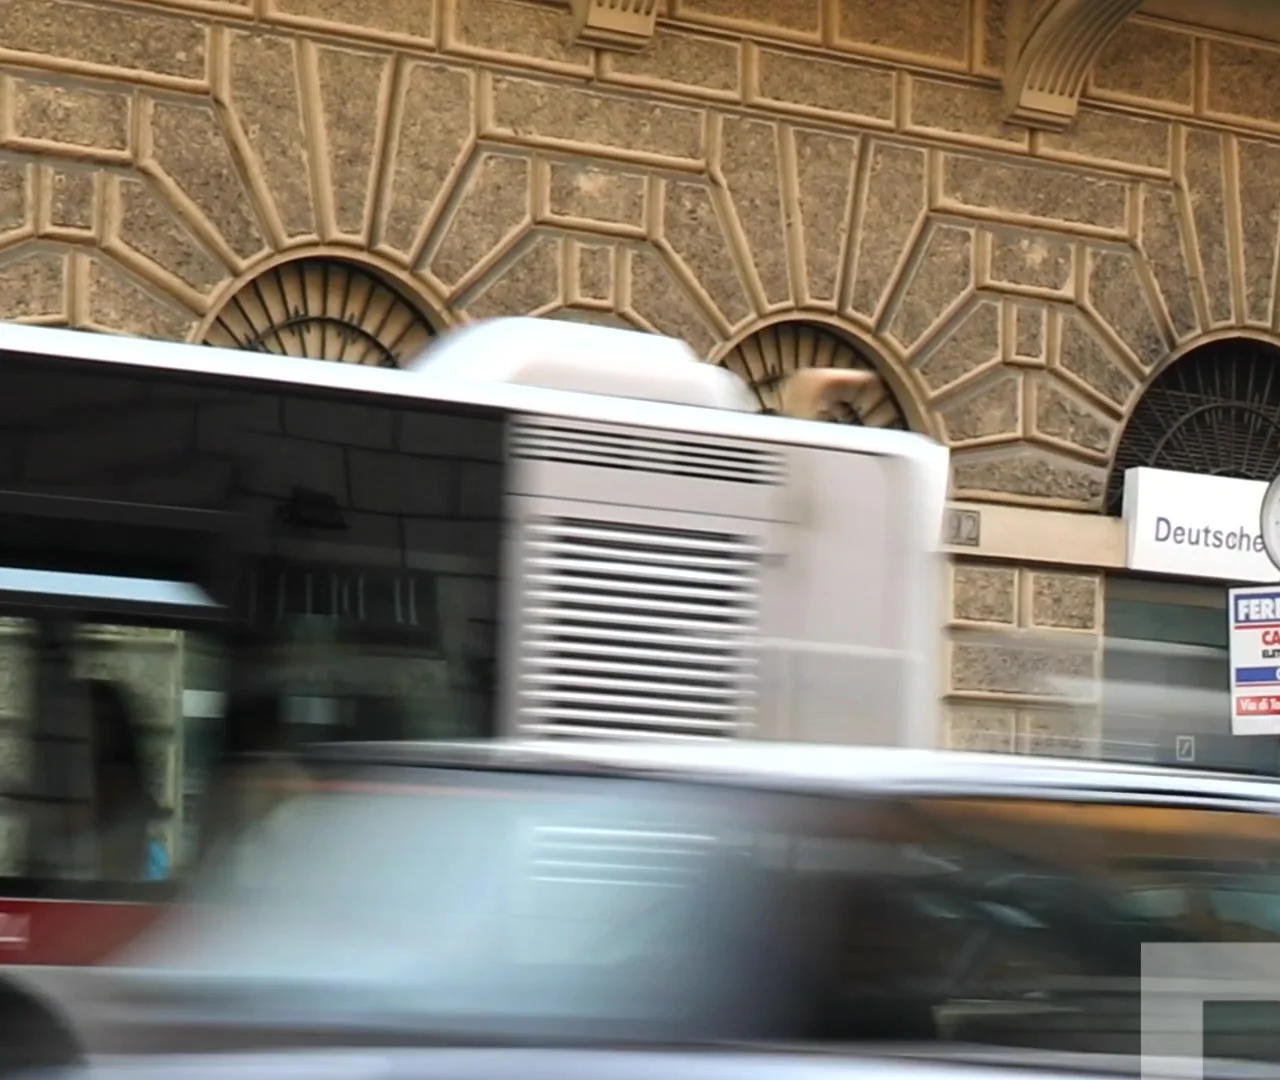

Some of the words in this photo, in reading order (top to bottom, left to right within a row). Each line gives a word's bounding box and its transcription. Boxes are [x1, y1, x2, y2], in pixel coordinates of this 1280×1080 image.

[1154, 515, 1265, 554] Deutsche
[1240, 699, 1256, 711] Via
[1258, 698, 1269, 711] di
